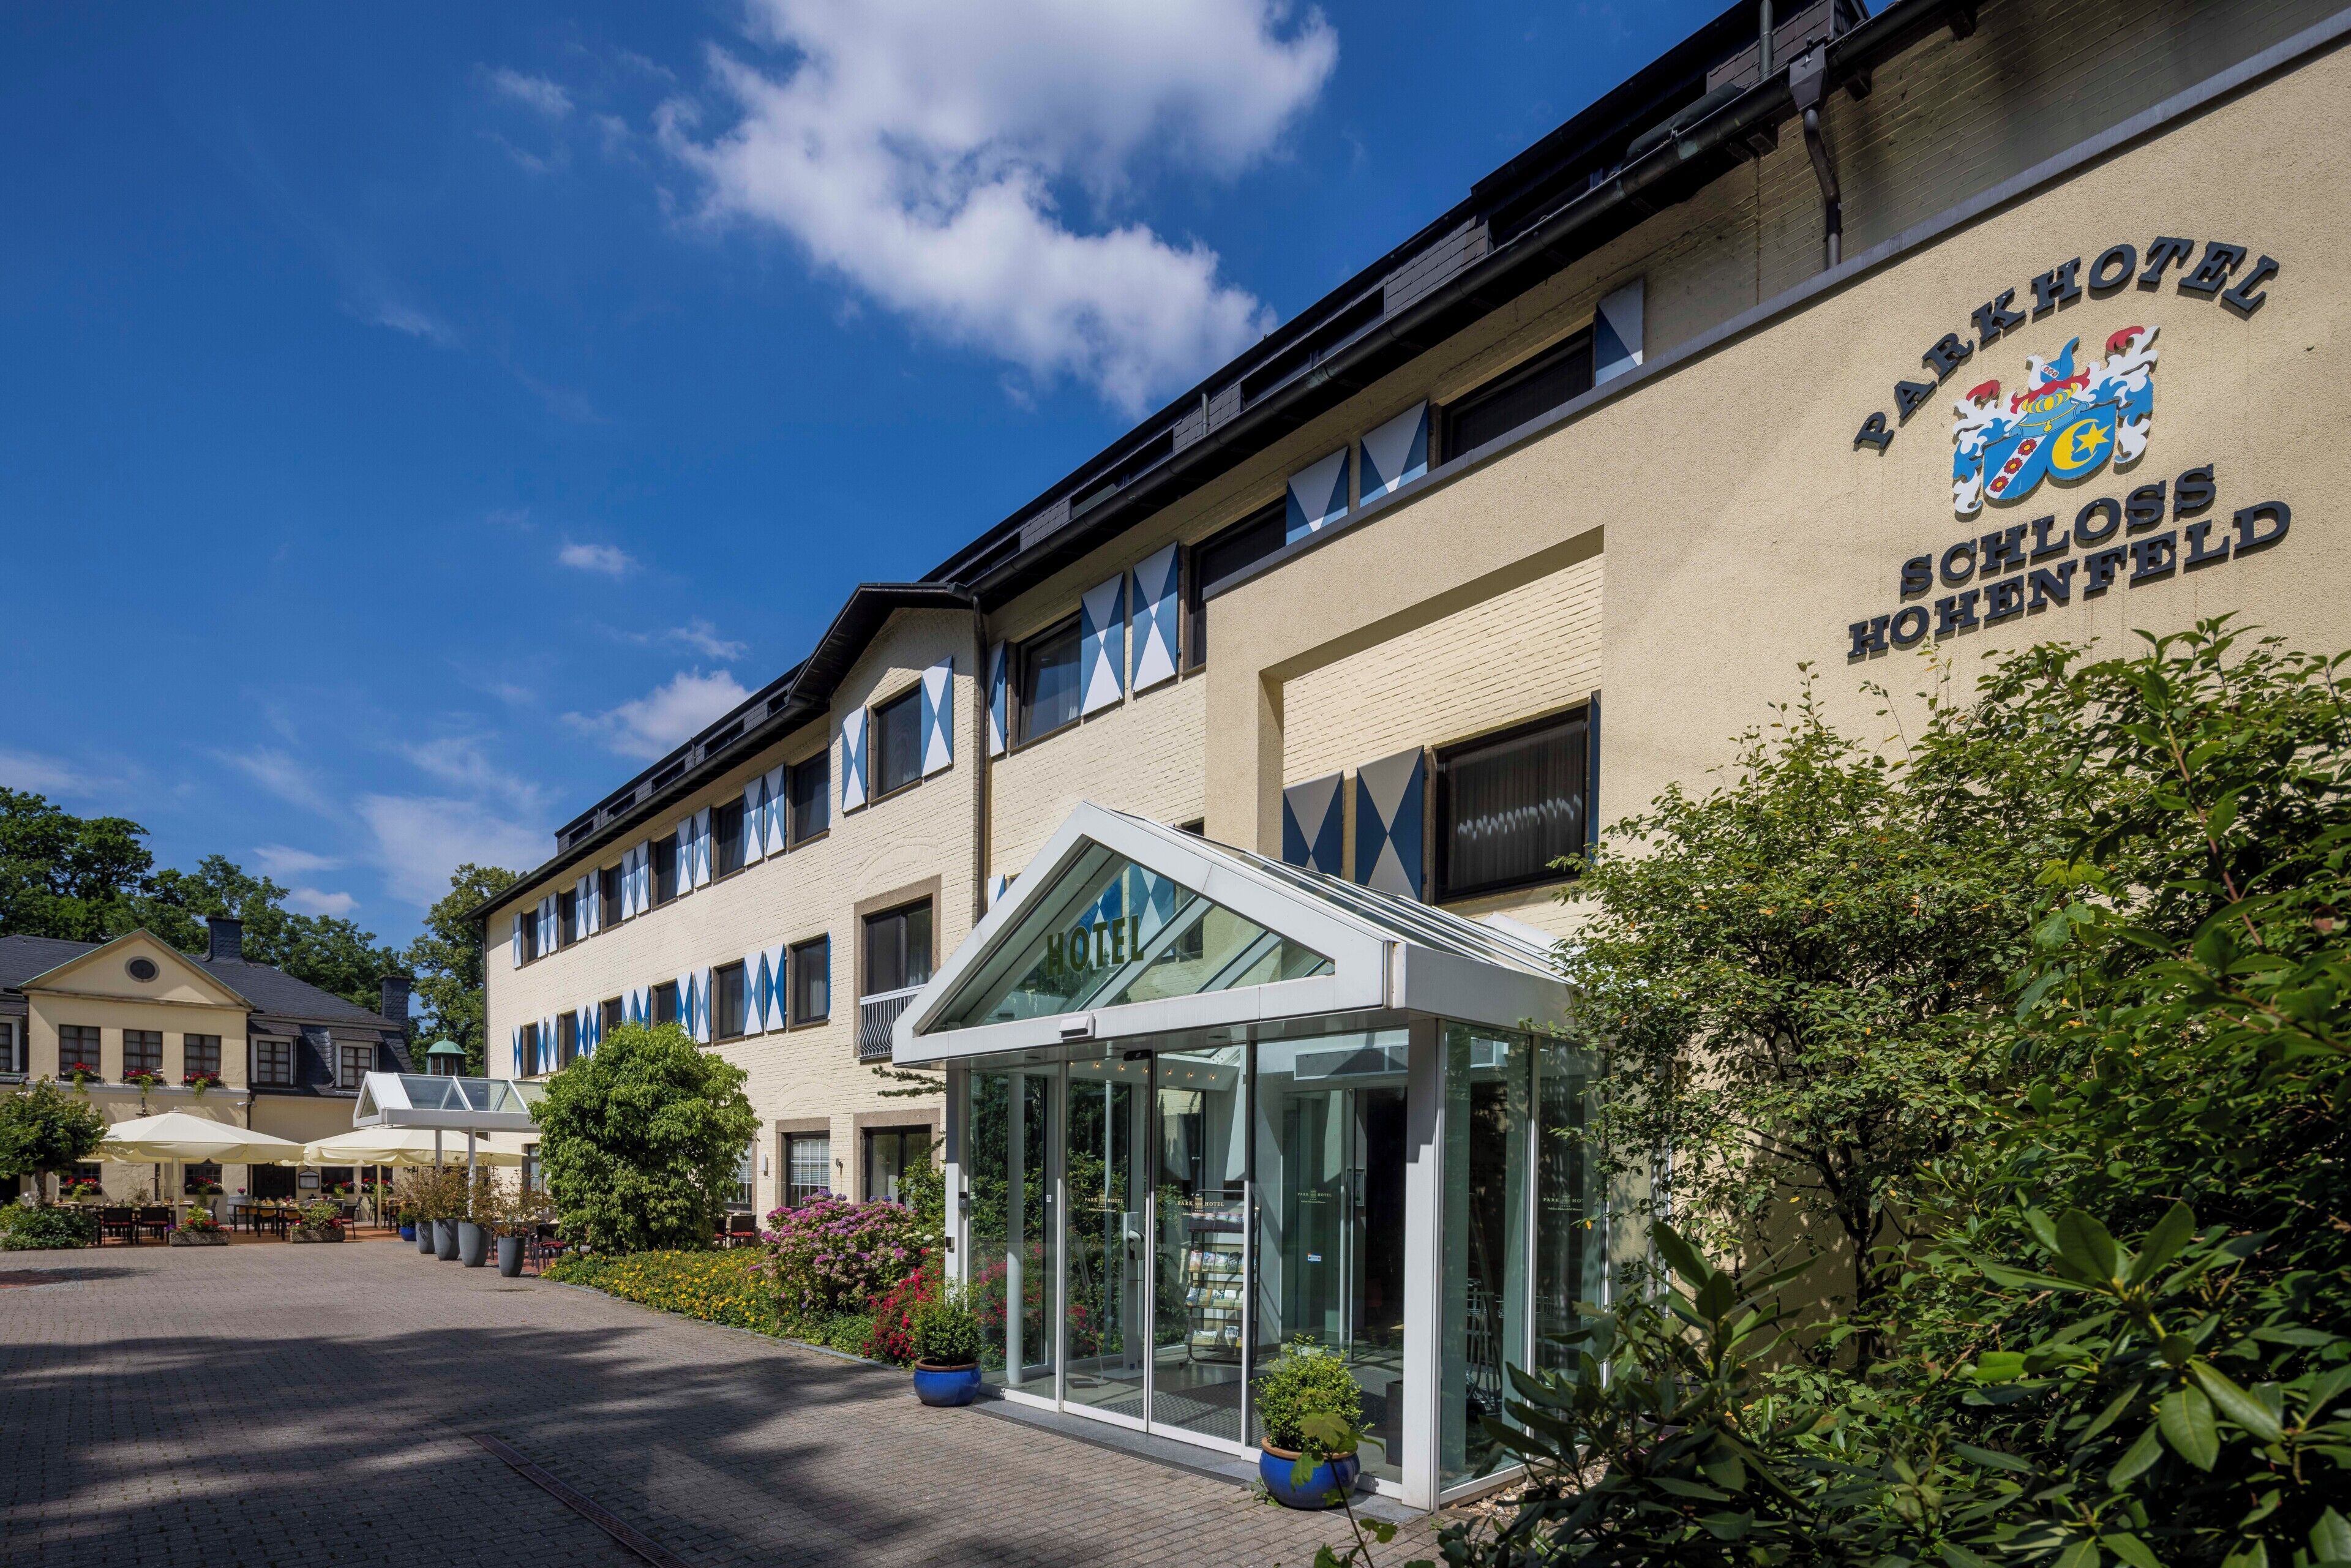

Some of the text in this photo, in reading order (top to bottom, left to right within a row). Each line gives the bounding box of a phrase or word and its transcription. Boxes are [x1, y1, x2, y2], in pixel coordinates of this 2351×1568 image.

[1853, 236, 2279, 454] PARKHOTEL
[1847, 501, 2292, 658] HOHENFELD
[1900, 463, 2216, 601] SCHLOSS
[1047, 914, 1144, 978] HOTEL
